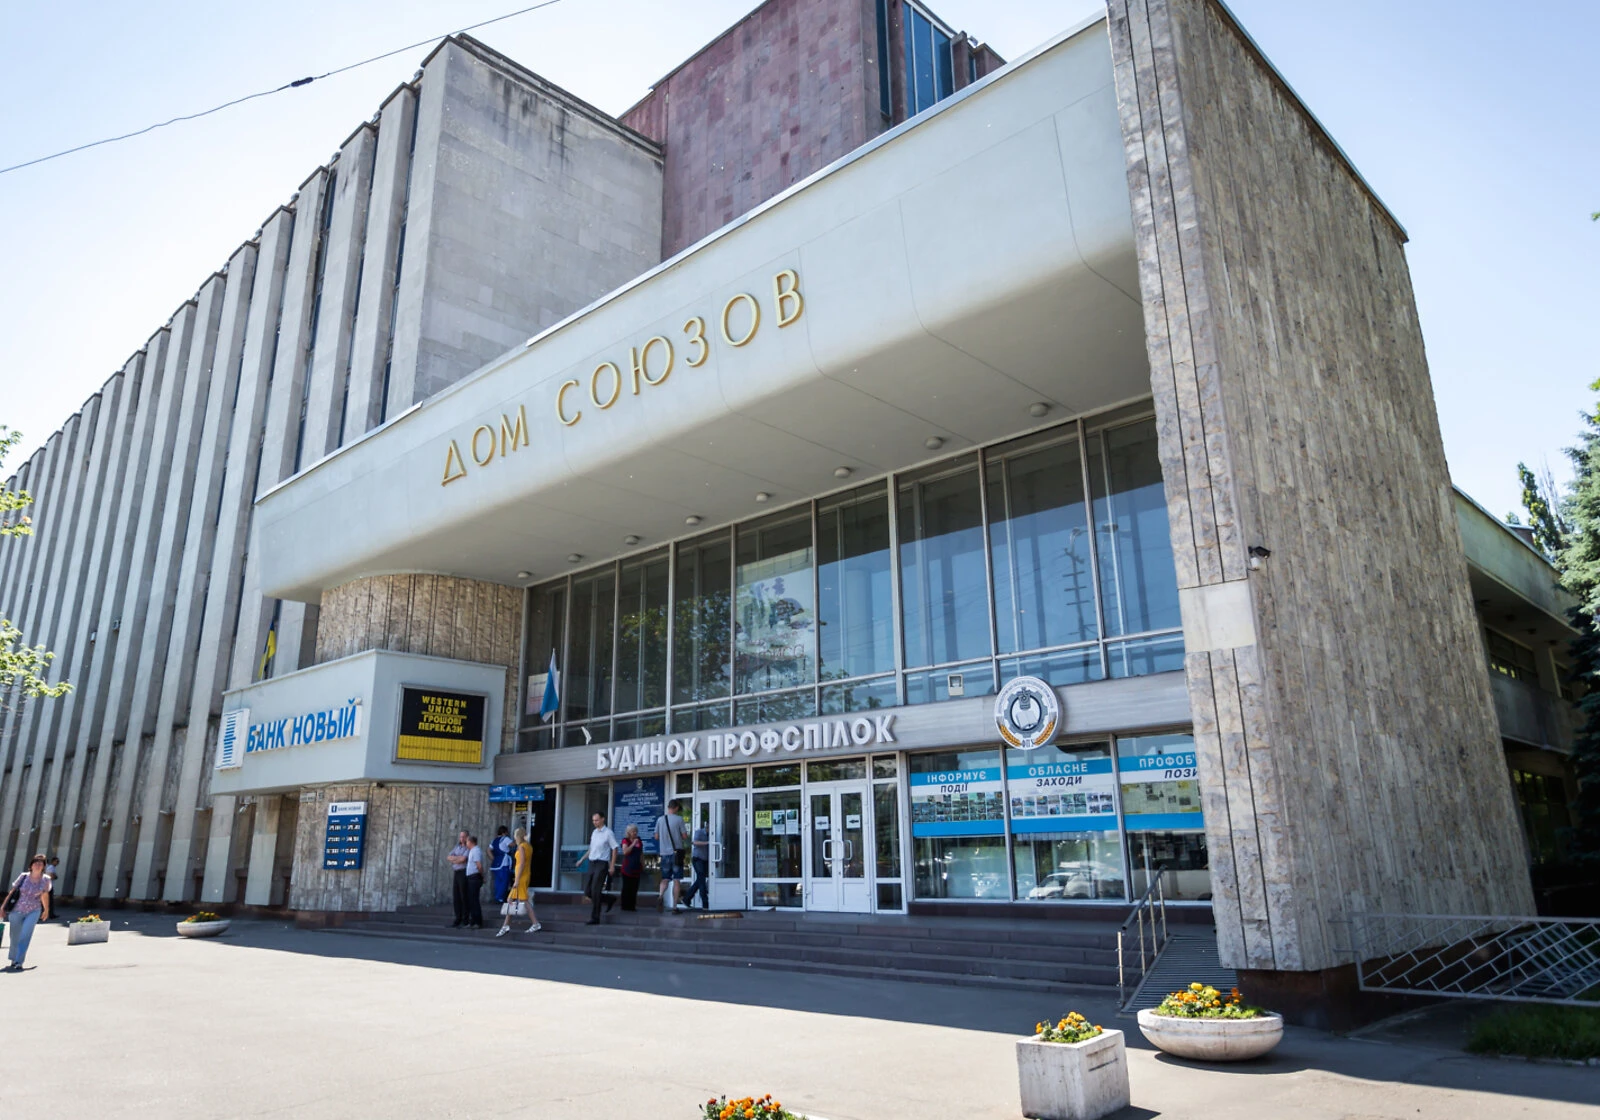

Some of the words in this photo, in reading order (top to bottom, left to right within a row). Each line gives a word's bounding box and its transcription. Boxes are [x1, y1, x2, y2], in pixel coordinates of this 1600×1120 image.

[441, 404, 530, 487] ДОМ
[555, 268, 804, 427] СОЮЗОВ
[421, 695, 467, 709] WESTERN
[427, 704, 460, 715] UNION
[246, 718, 288, 753] БАНК
[291, 698, 356, 746] НОВЫЙ
[423, 714, 462, 726] ГРОШОВІ
[418, 722, 463, 734] ПЕРЕКАЗИ
[597, 736, 700, 772] БУДИНОК
[707, 714, 897, 760] ПРОФСПІЛОК
[1028, 763, 1088, 777] ОБЛАСНЕ
[927, 771, 987, 783] ІНФОРМУЄ
[1036, 776, 1082, 788] ЗАХОДИ
[940, 783, 969, 794] ПОДІЇ
